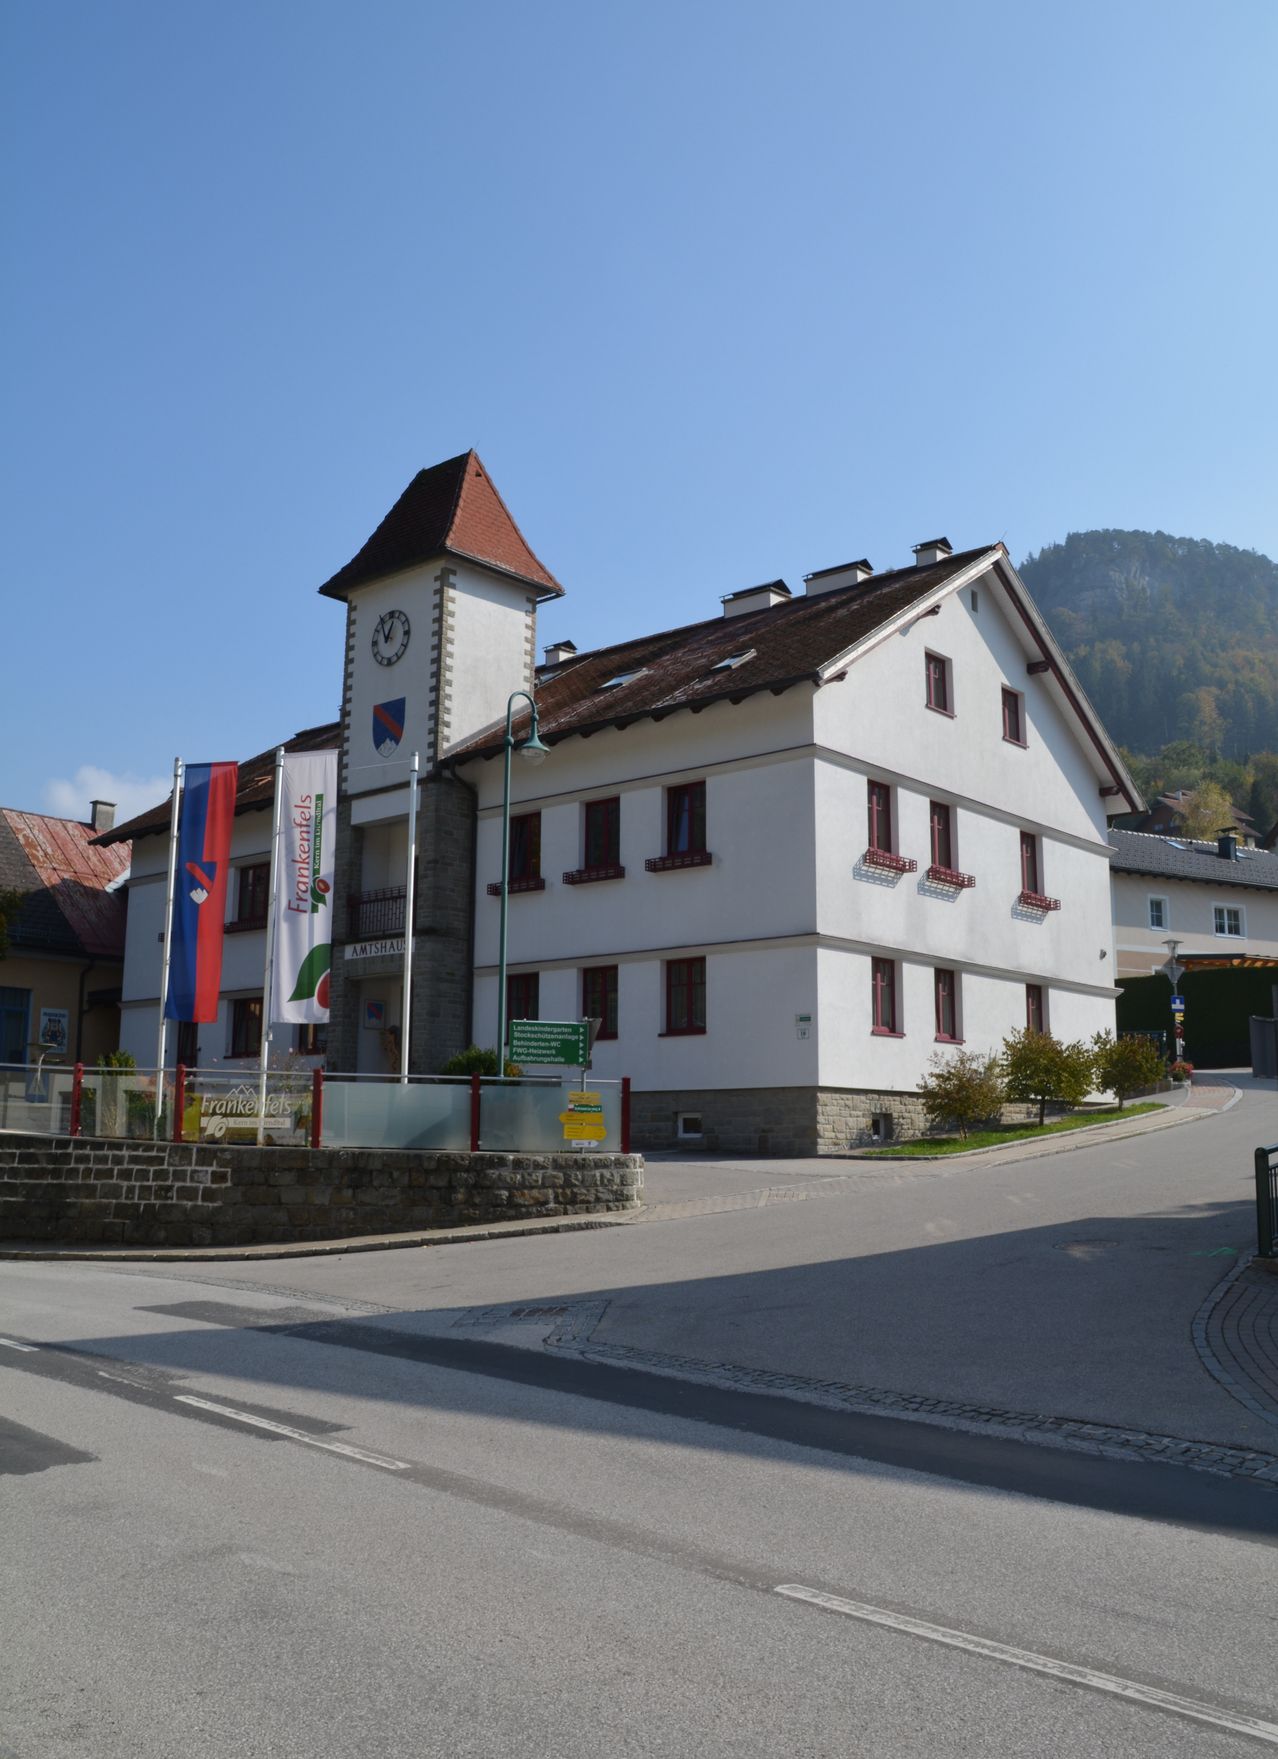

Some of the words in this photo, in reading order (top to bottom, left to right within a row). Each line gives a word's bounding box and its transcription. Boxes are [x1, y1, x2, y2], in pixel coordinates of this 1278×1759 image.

[287, 794, 312, 914] Frankenfels
[513, 1025, 572, 1034] Landeskindergarten
[513, 1032, 579, 1040] Stockschützenanlage
[512, 1040, 561, 1048] Behinderten-WC
[512, 1047, 556, 1055] FWG-Heizwerk
[512, 1055, 565, 1063] Aufbahrungshalle
